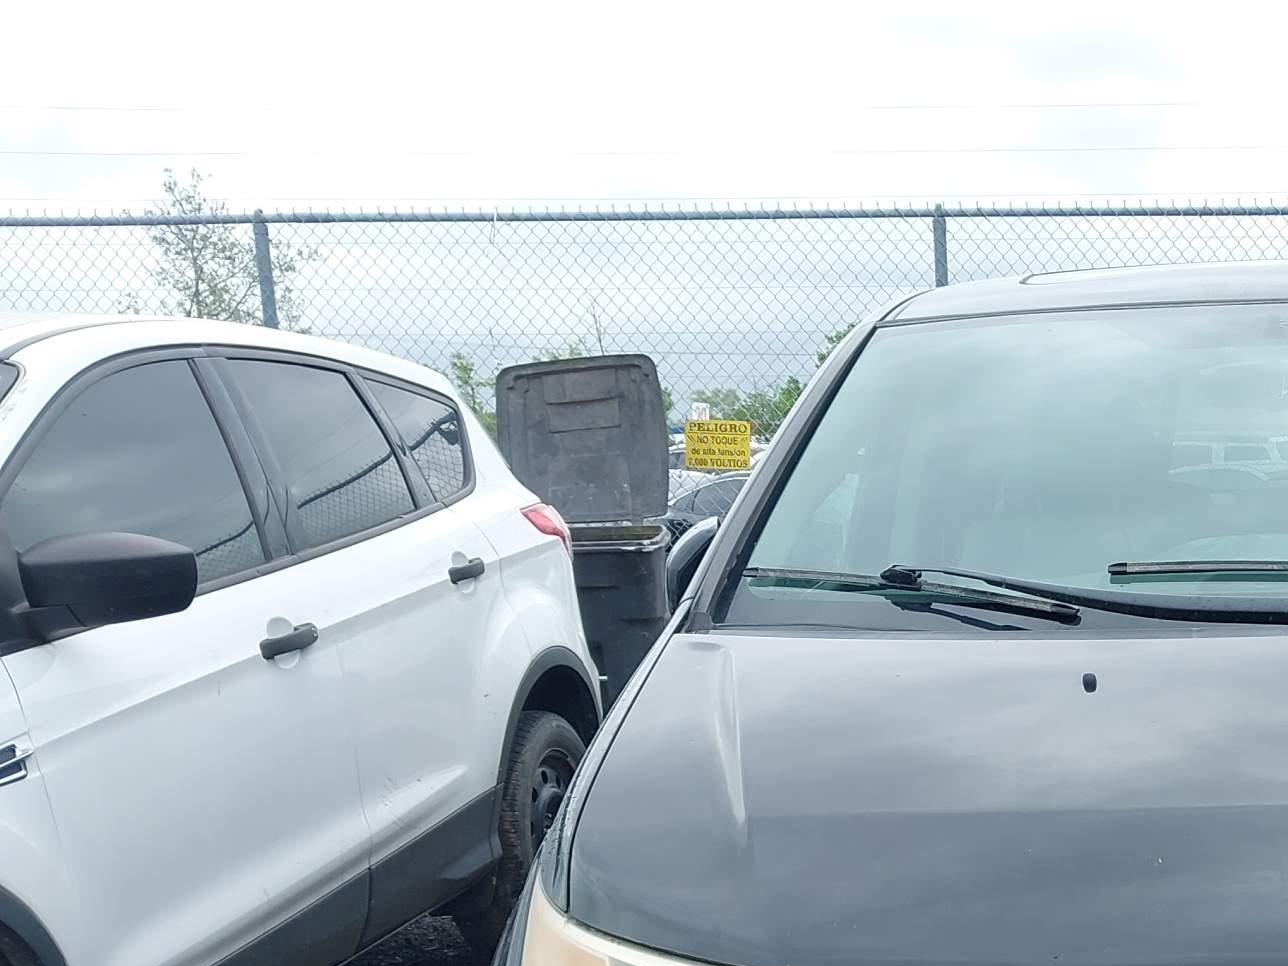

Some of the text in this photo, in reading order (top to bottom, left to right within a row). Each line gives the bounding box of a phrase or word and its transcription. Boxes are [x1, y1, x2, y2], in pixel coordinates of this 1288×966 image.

[688, 423, 748, 434] PELIGRO
[697, 435, 739, 446] NO TOQUE
[710, 458, 748, 468] VOLTIOS
